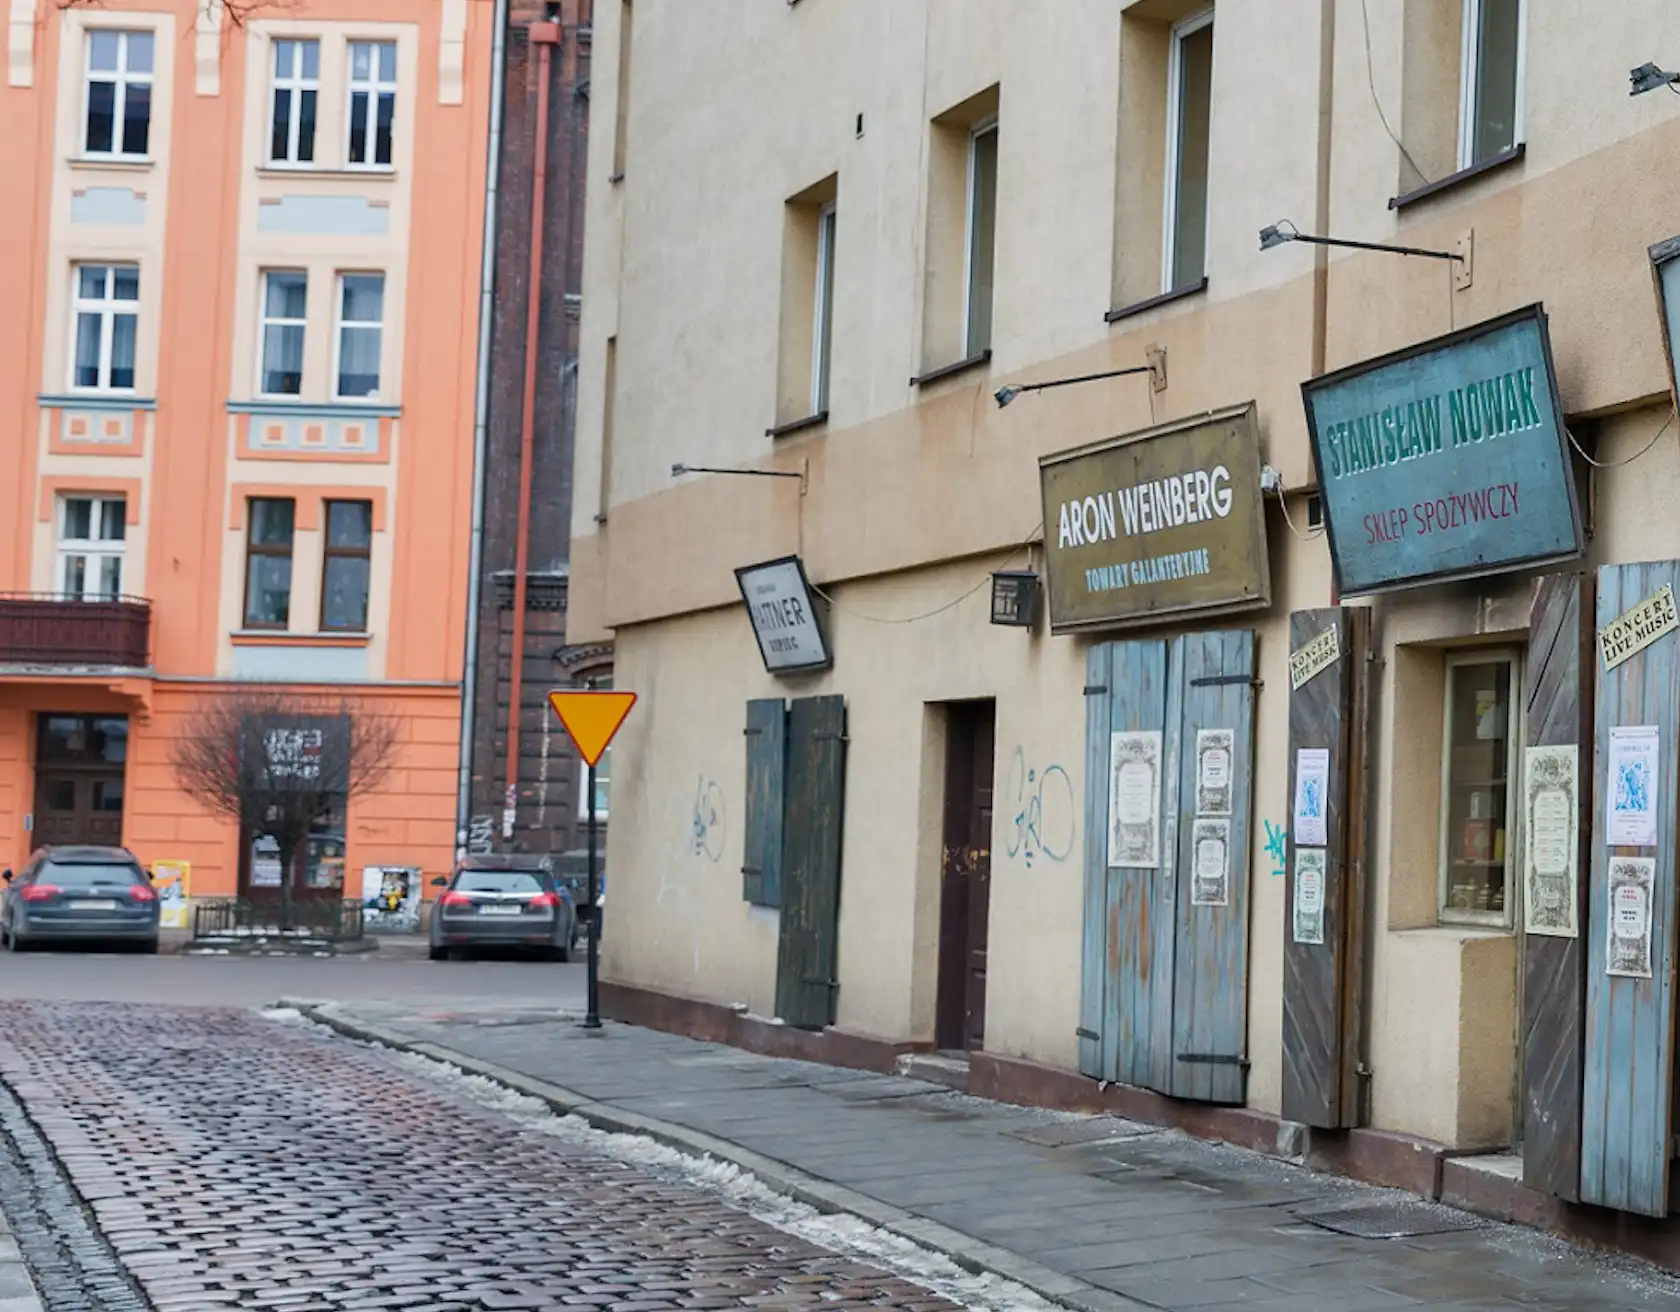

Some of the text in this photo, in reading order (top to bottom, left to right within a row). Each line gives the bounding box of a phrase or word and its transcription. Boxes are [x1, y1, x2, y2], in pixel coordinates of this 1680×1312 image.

[1326, 366, 1543, 480] STANISŁAW NOWAK
[1058, 464, 1233, 549] ARON WEINBERG
[1363, 507, 1409, 545] SKLEP
[1085, 548, 1210, 592] TOWARY GALANTERYJNE
[1601, 593, 1671, 648] KONCERT
[1605, 608, 1675, 662] LIVE MUSIC
